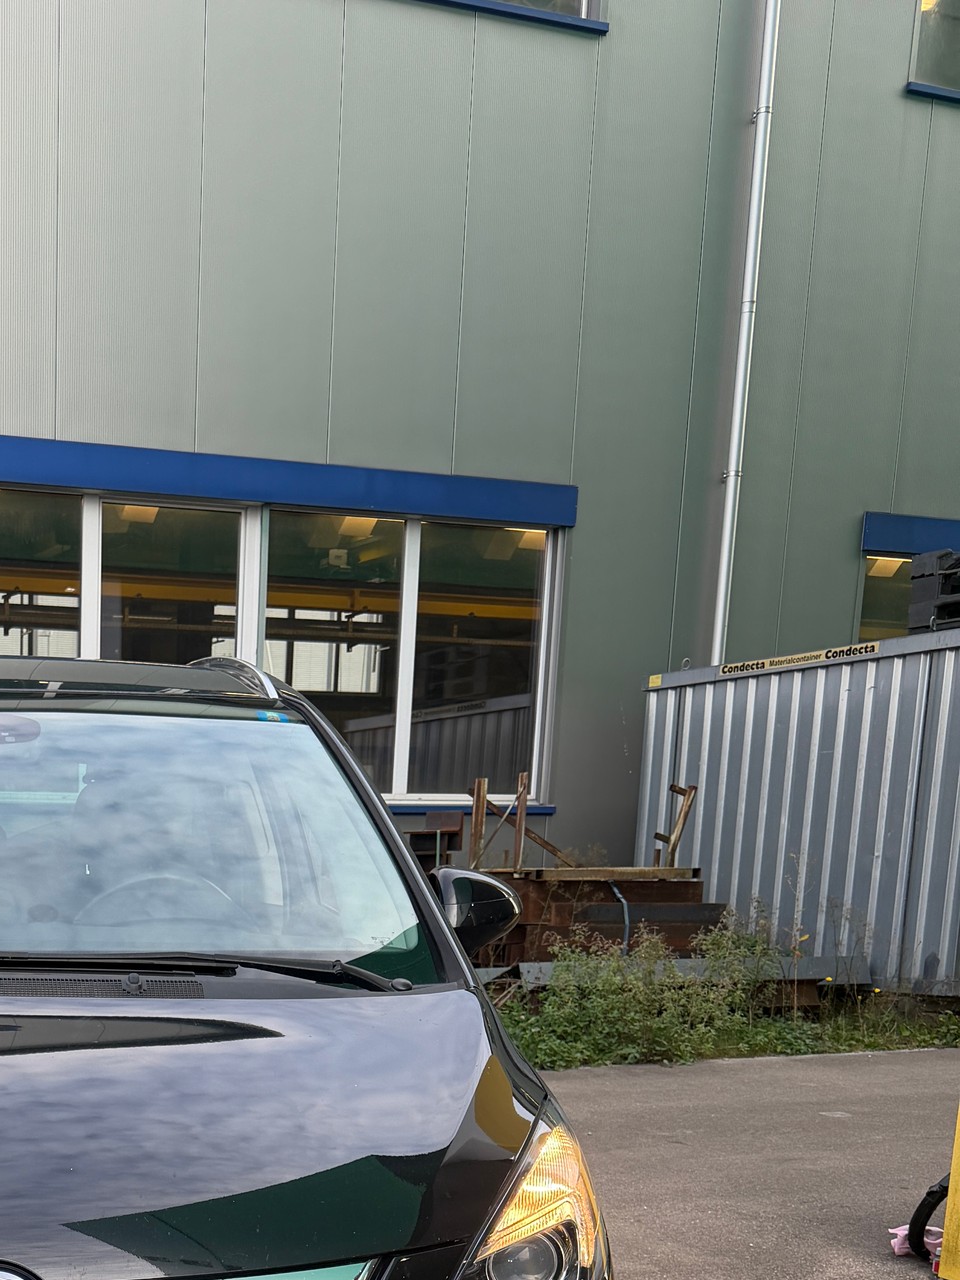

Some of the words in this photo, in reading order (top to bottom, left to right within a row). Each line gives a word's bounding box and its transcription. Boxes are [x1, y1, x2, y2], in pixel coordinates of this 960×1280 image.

[721, 660, 766, 675] Condecta
[768, 652, 823, 668] Materialcontainer
[824, 643, 876, 660] Condecta
